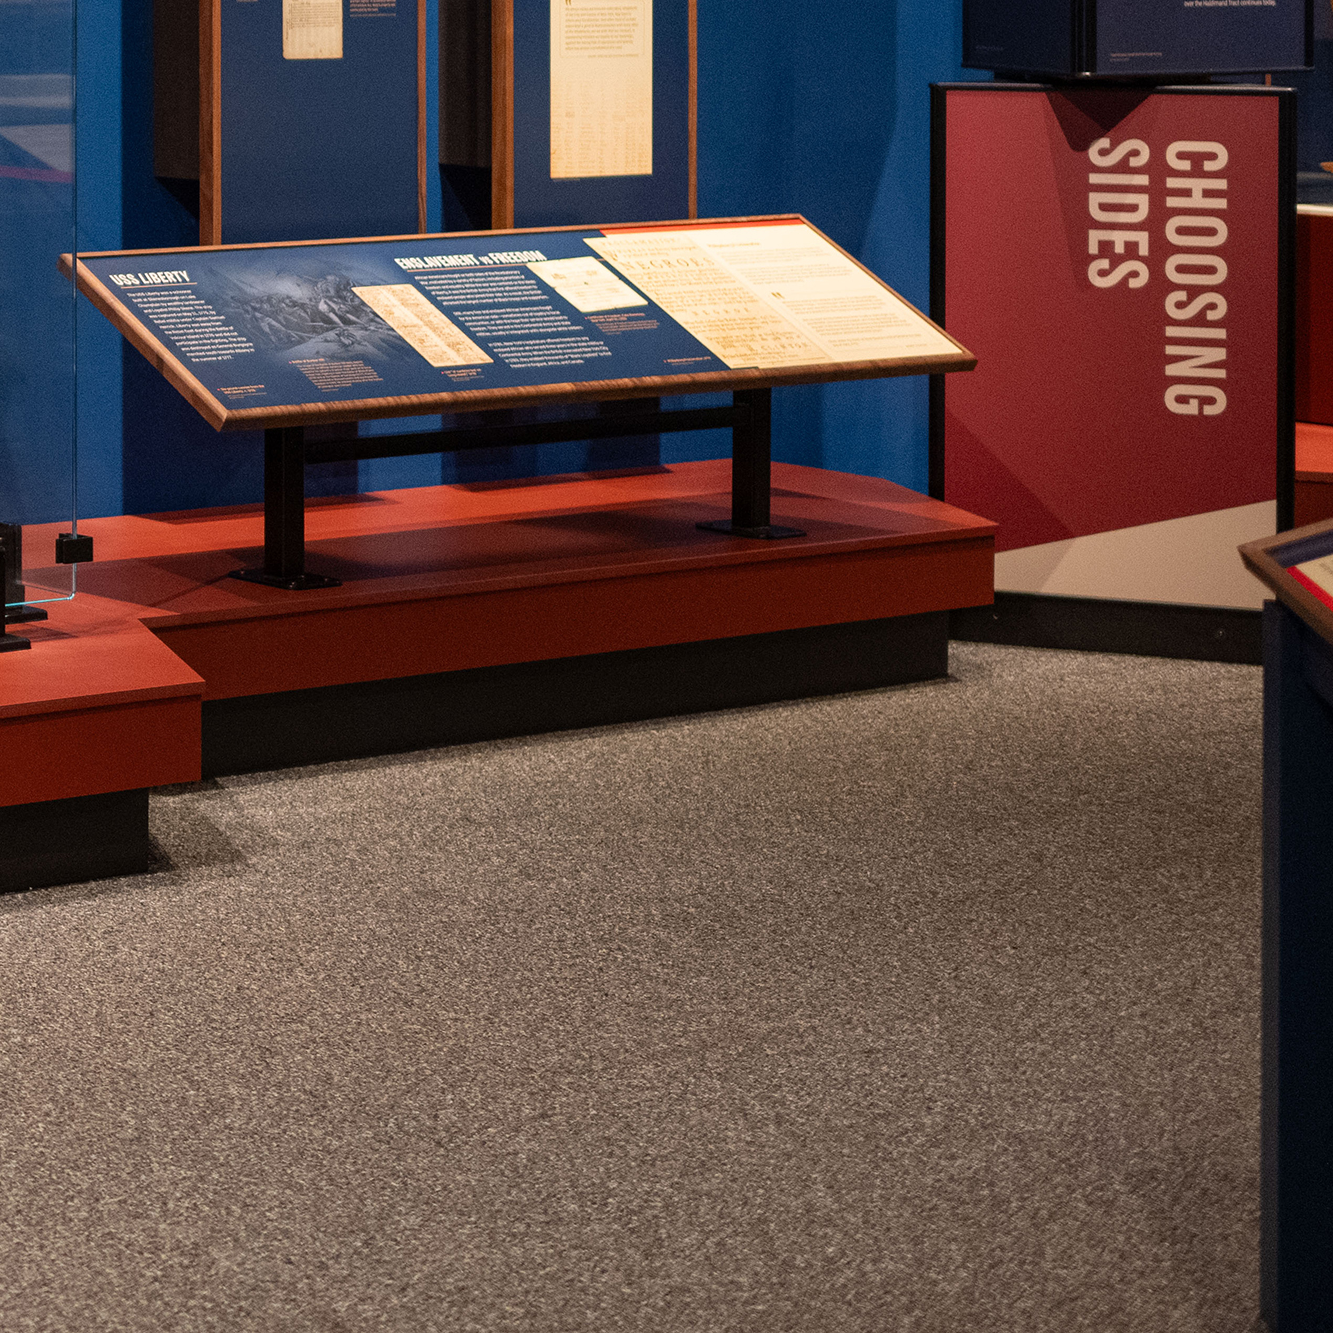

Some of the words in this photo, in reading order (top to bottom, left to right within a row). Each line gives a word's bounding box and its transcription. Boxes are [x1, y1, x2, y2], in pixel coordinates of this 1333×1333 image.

[1087, 137, 1150, 289] SIDES
[108, 273, 141, 287] USS
[137, 270, 191, 285] LIBERTY
[393, 254, 481, 270] ENSLAVEMENT
[487, 250, 548, 265] FREEDOM
[1163, 140, 1229, 417] CHOOSING
